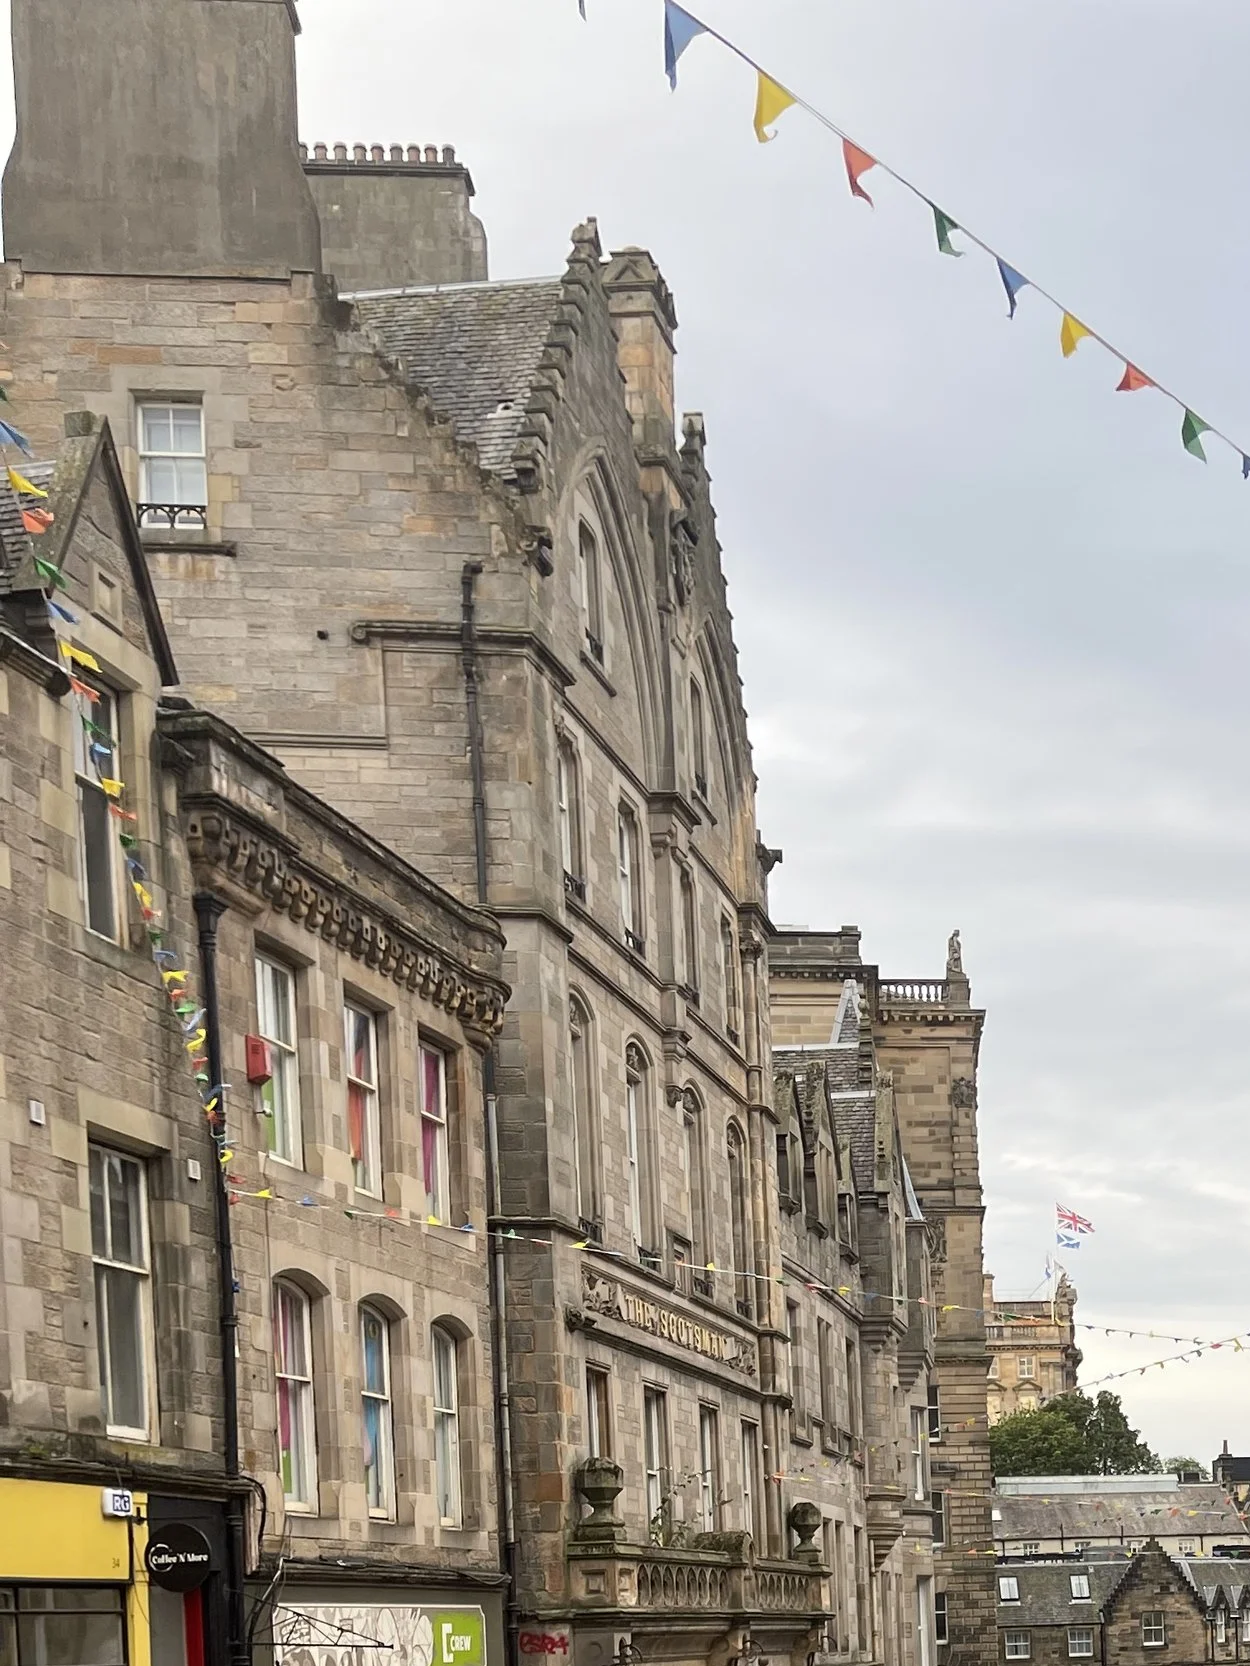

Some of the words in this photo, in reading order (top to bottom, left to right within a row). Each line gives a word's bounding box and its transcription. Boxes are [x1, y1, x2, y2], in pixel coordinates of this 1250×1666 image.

[626, 1294, 651, 1328] THE
[660, 1309, 727, 1360] SCOTSMAN
[112, 1495, 130, 1512] RG
[151, 1555, 177, 1565] Coffee
[187, 1553, 208, 1562] More
[451, 1635, 471, 1652] CREW
